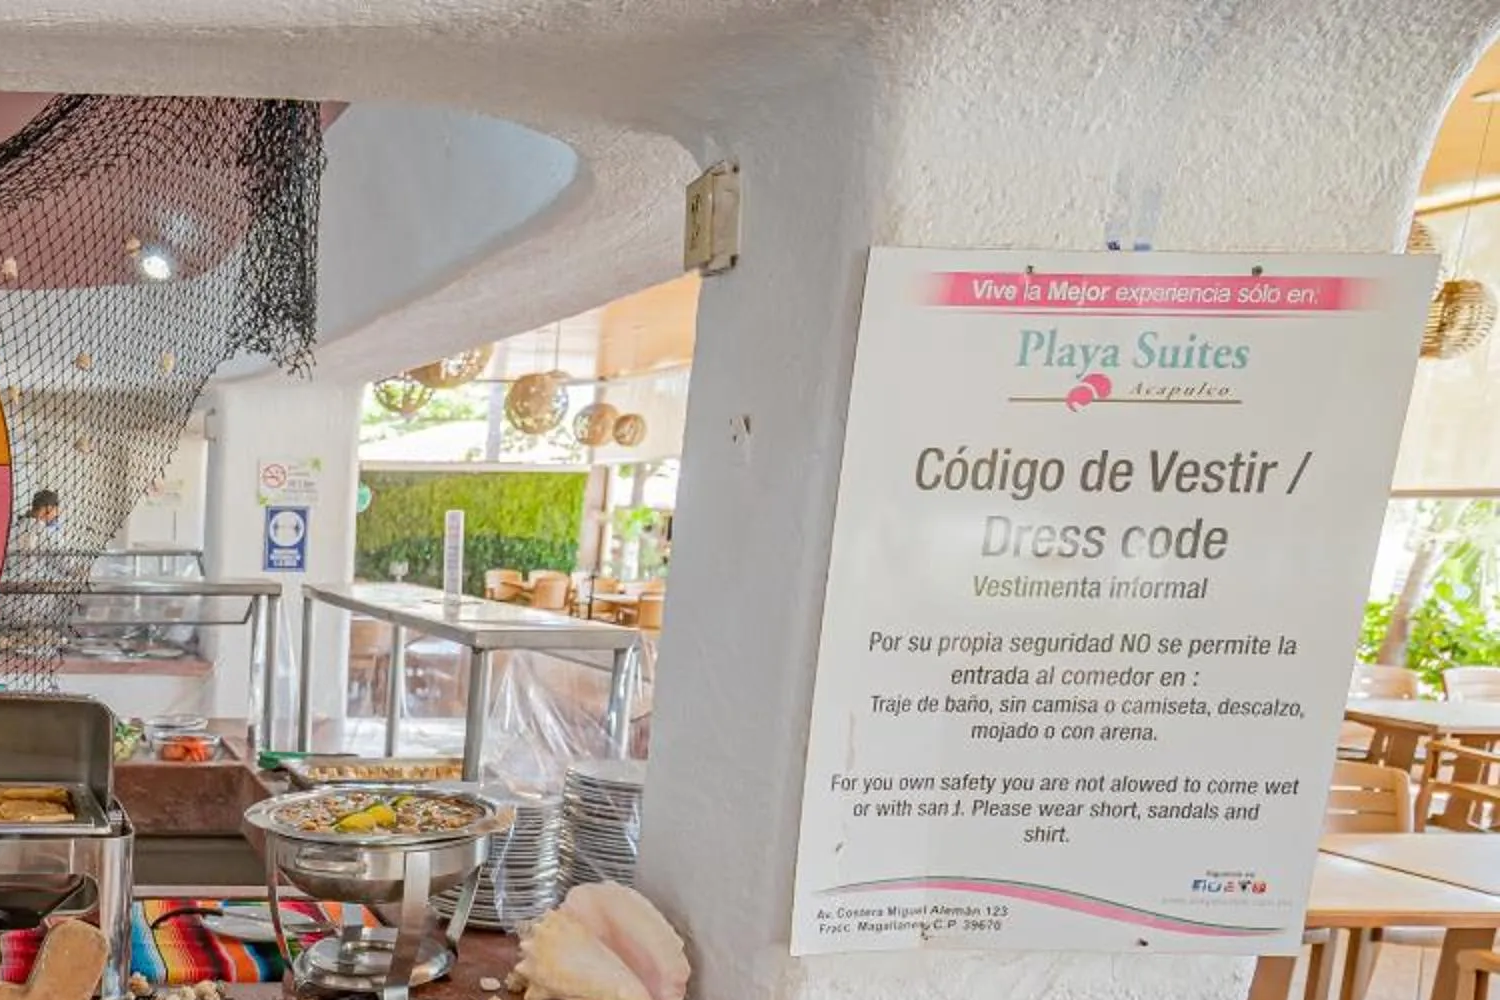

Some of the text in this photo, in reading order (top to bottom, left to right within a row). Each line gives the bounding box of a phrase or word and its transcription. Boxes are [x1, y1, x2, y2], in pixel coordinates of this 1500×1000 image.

[972, 279, 1017, 300] Vive
[1024, 279, 1040, 301] la
[1048, 280, 1110, 306] Mejor
[1115, 282, 1230, 306] experiencia
[1237, 283, 1280, 304] sólo
[1015, 328, 1250, 378] Playa Suites
[1128, 380, 1232, 400] Acapulco
[915, 445, 1313, 501] Código de Vestir /
[981, 515, 1229, 560] Dress code
[973, 575, 1209, 599] Vestimenta informal
[869, 631, 1298, 658] Por su propia seguridad NO se permite la
[951, 665, 1029, 685] entrada
[1035, 665, 1055, 685] al
[1061, 665, 1154, 686] comedor
[1160, 670, 1186, 687] en
[871, 694, 1305, 719] Traje de baño, sin camisa o camiseta, descalzo,
[971, 722, 1157, 742] mojado o con arena.
[831, 774, 1300, 795] For you own safety you are not alowed to come wet
[853, 802, 870, 817] or
[875, 800, 912, 817] with
[971, 799, 1033, 817] Please
[1038, 802, 1084, 818] wear
[1090, 801, 1141, 820] short,
[1148, 802, 1219, 820] sandals
[1224, 803, 1261, 821] and
[1023, 826, 1069, 843] shirt.
[986, 905, 1009, 917] 123
